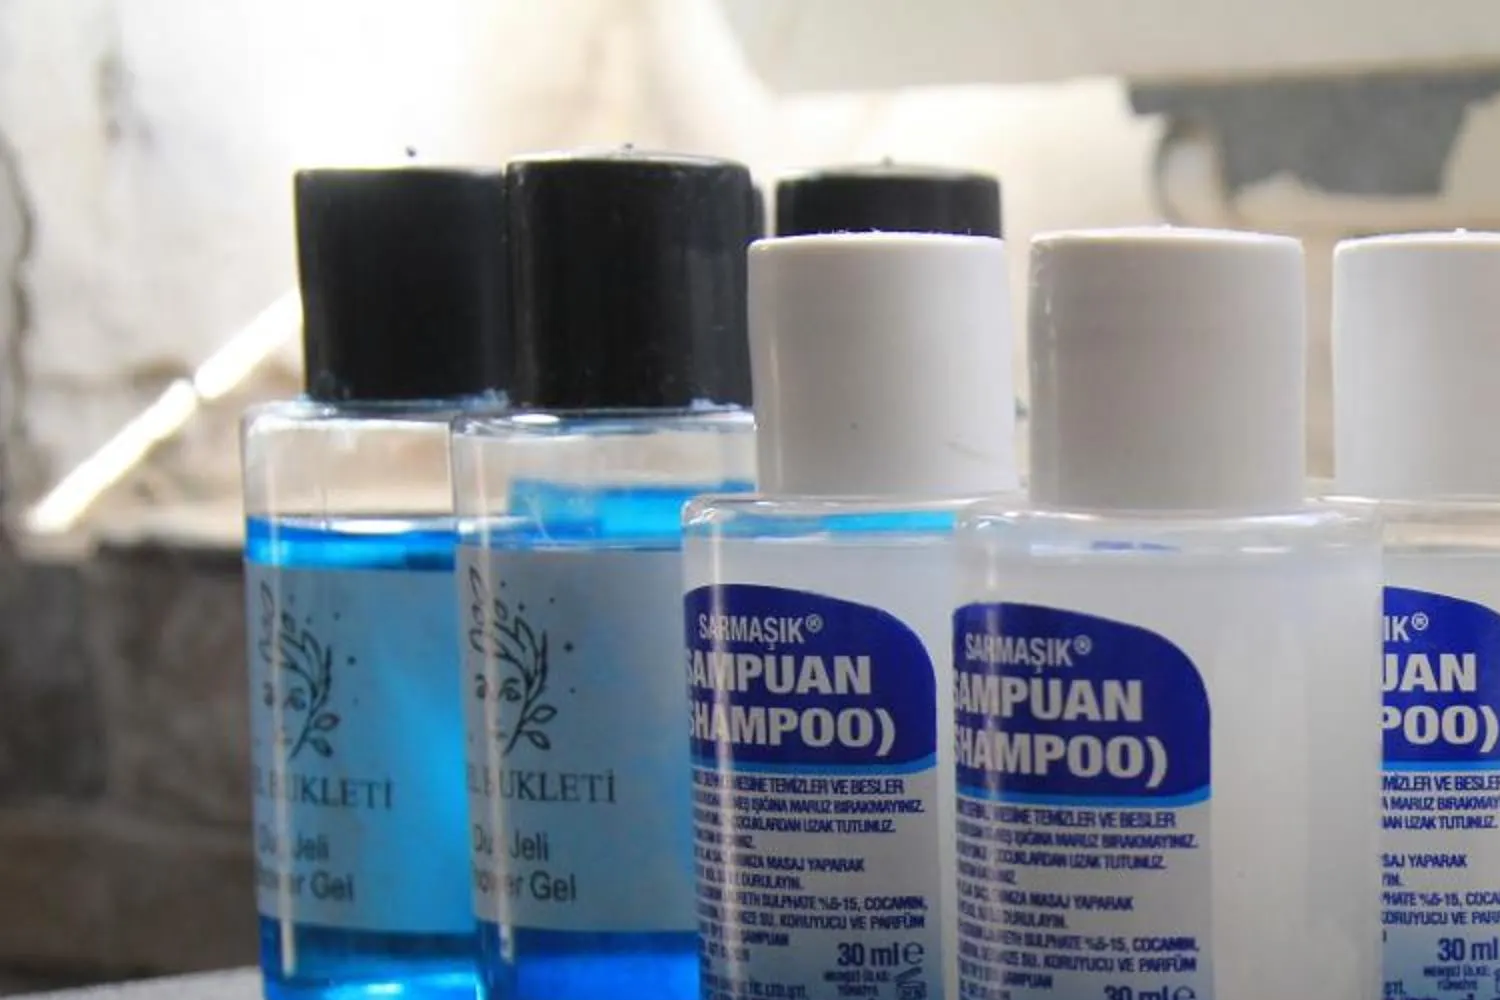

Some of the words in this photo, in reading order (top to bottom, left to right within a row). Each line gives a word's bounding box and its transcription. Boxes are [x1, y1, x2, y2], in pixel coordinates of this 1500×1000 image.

[832, 779, 849, 795] VE
[850, 778, 905, 796] BESLER
[1434, 776, 1452, 791] VE
[1099, 811, 1119, 828] VE
[509, 828, 550, 863] Jeli
[529, 869, 577, 904] Gel
[849, 915, 866, 930] VE
[1451, 911, 1469, 925] VE
[837, 941, 864, 967] 30
[870, 941, 899, 967] ml
[1437, 936, 1465, 962] 30
[1470, 936, 1499, 962] ml
[1117, 956, 1135, 973] VE
